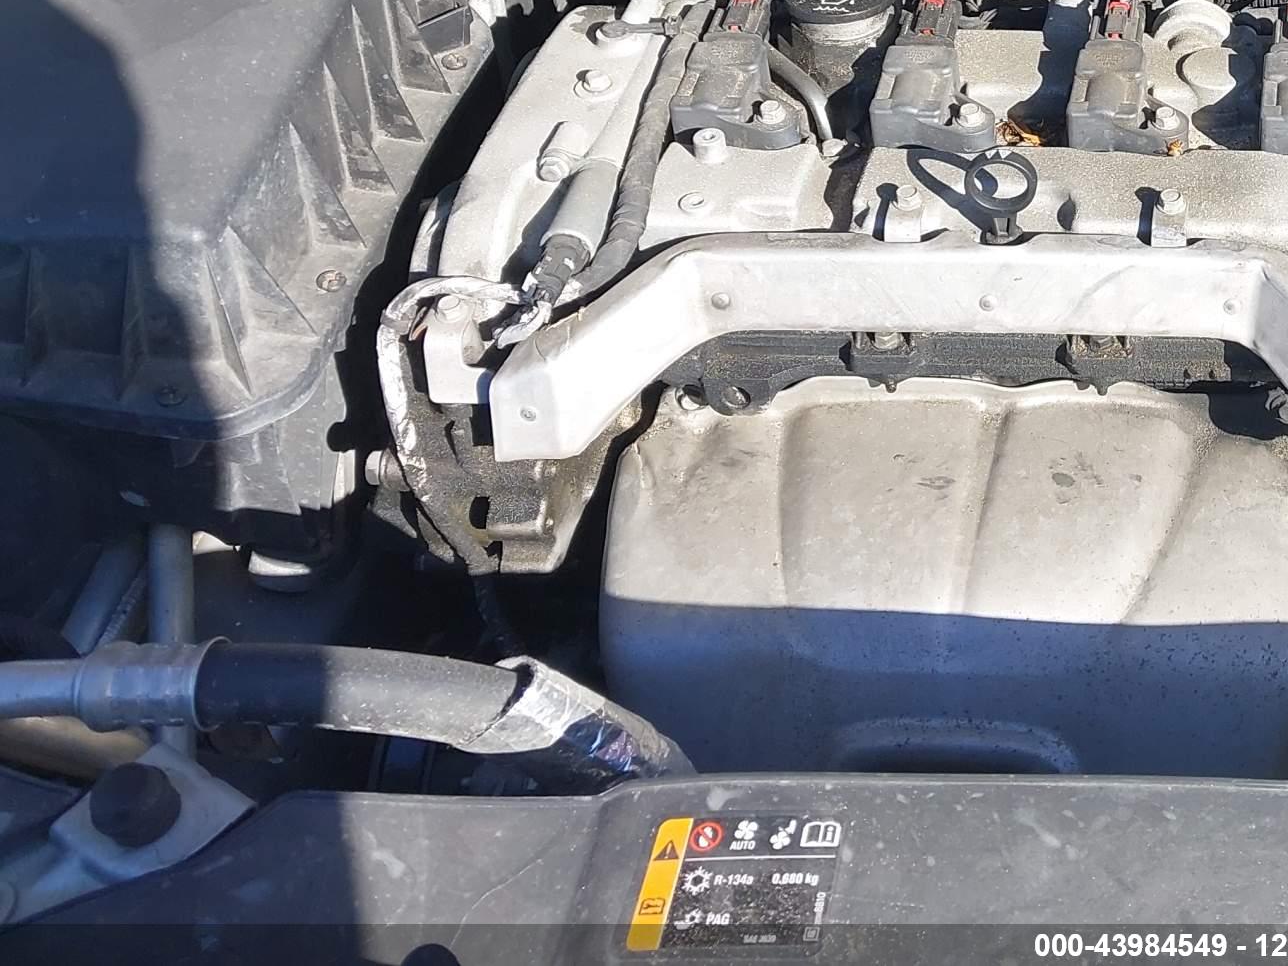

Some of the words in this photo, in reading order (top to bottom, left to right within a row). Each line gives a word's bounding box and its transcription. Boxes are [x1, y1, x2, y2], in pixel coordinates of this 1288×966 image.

[729, 840, 756, 850] AUTO
[713, 873, 755, 885] R-134a
[804, 872, 820, 886] kg
[705, 913, 731, 925] PAG
